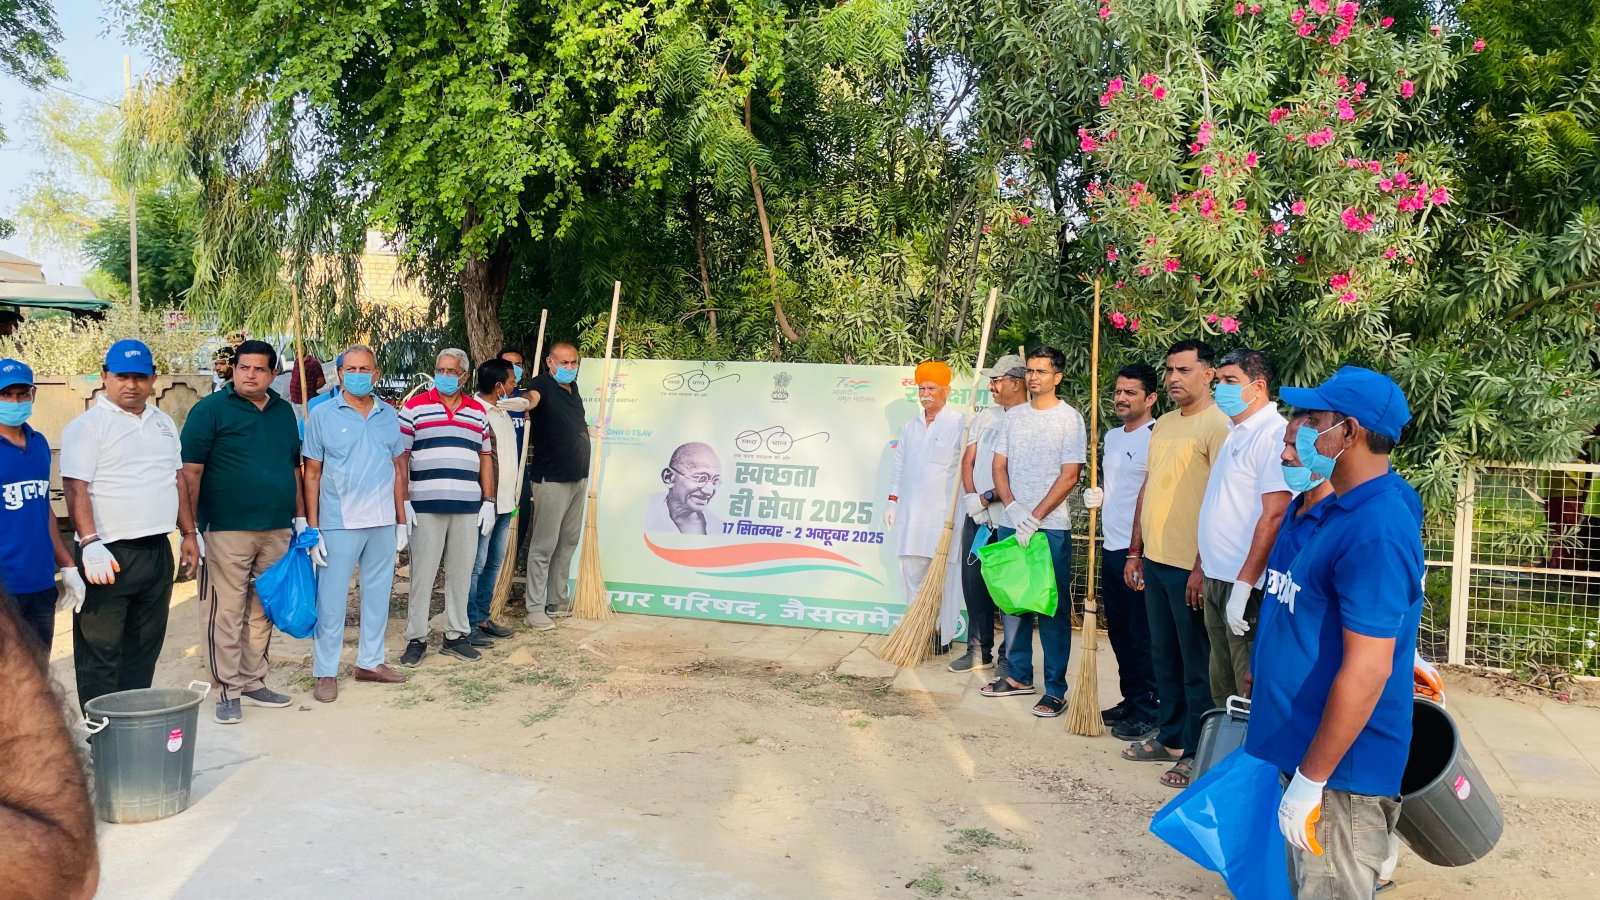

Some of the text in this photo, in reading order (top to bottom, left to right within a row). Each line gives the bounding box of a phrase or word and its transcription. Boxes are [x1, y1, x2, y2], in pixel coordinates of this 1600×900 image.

[735, 462, 819, 488] स्वच्छता
[728, 488, 873, 525] ही सेवा 2025
[722, 521, 735, 534] 17
[736, 519, 783, 538] सितम्बर
[794, 527, 803, 539] 2
[805, 527, 850, 547] अक्टूबर
[851, 530, 885, 544] 2025
[661, 591, 768, 620] परिषद,
